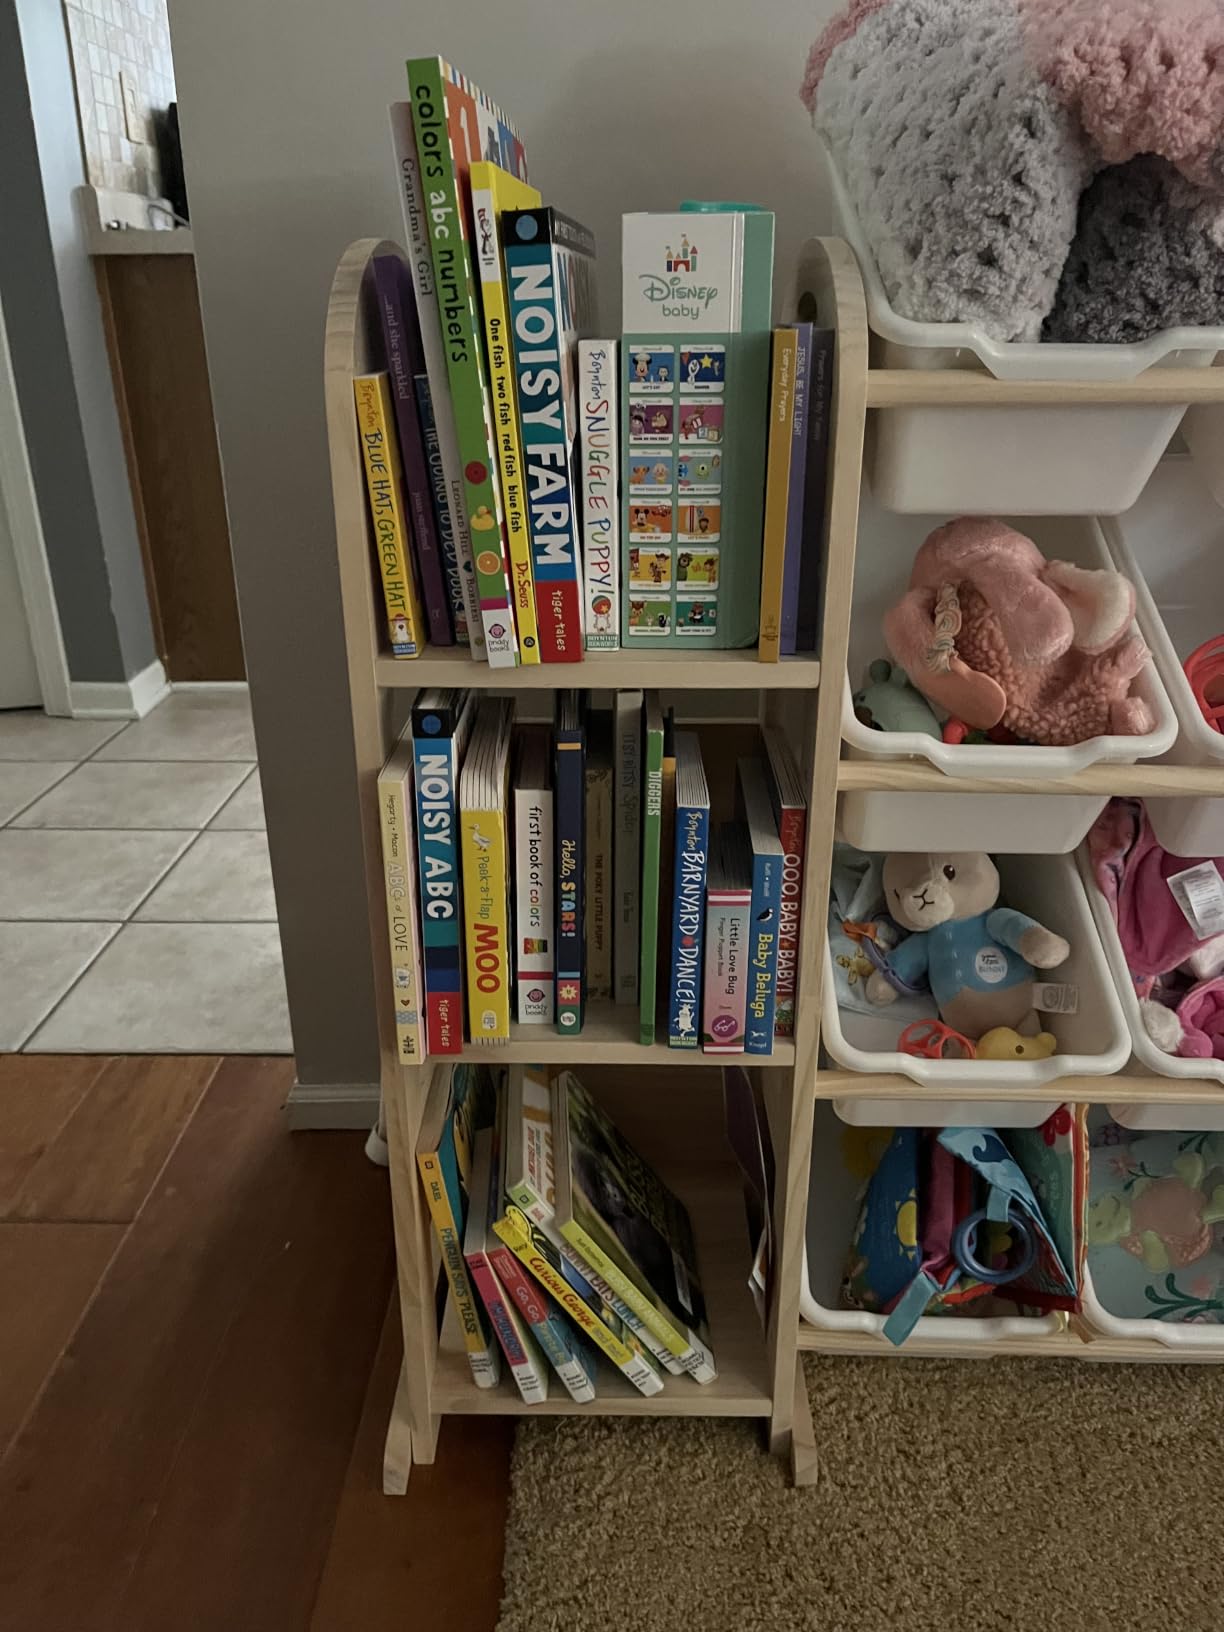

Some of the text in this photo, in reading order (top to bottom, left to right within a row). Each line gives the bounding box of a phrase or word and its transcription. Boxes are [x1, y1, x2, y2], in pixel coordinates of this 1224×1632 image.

[401, 158, 433, 296] Grandma's Girl
[414, 84, 468, 362] colors abc numbers
[638, 273, 719, 310] Disney
[662, 303, 700, 320] baby
[510, 263, 572, 565] NOISY FARM
[779, 348, 792, 422] Everyday Prayers
[364, 427, 388, 474] BLUE
[489, 317, 522, 533] One fish two fish red fish blue fish
[585, 400, 609, 509] SNUGGLE
[372, 479, 393, 518] HAT,
[451, 480, 465, 528] LEONARD
[459, 530, 470, 555] HILL
[377, 519, 398, 577] GREEN
[587, 518, 614, 594] PUPPY!
[386, 581, 406, 611] HAT
[517, 577, 531, 609] Seuss
[550, 590, 567, 652] tiger tales
[647, 770, 662, 816] DIGGERS
[419, 754, 454, 919] NOISY ABC
[529, 806, 544, 927] first book of colors
[560, 840, 576, 938] Hello, STARS!
[678, 851, 706, 936] BARNYARD
[779, 902, 798, 942] BABY
[393, 916, 409, 952] LOVE
[473, 923, 500, 993] MOO
[724, 918, 741, 996] Little Love Bug
[675, 945, 699, 1004] DANCE!
[753, 933, 774, 1019] Baby Beluga
[776, 951, 795, 992] BABY!
[438, 999, 450, 1048] tiger tales
[440, 1227, 461, 1271] PENGUIN
[451, 1271, 468, 1298] SAYS
[529, 1256, 565, 1294] Curious
[562, 1293, 595, 1328] George
[516, 1286, 528, 1305] Go,
[527, 1304, 540, 1323] Go,
